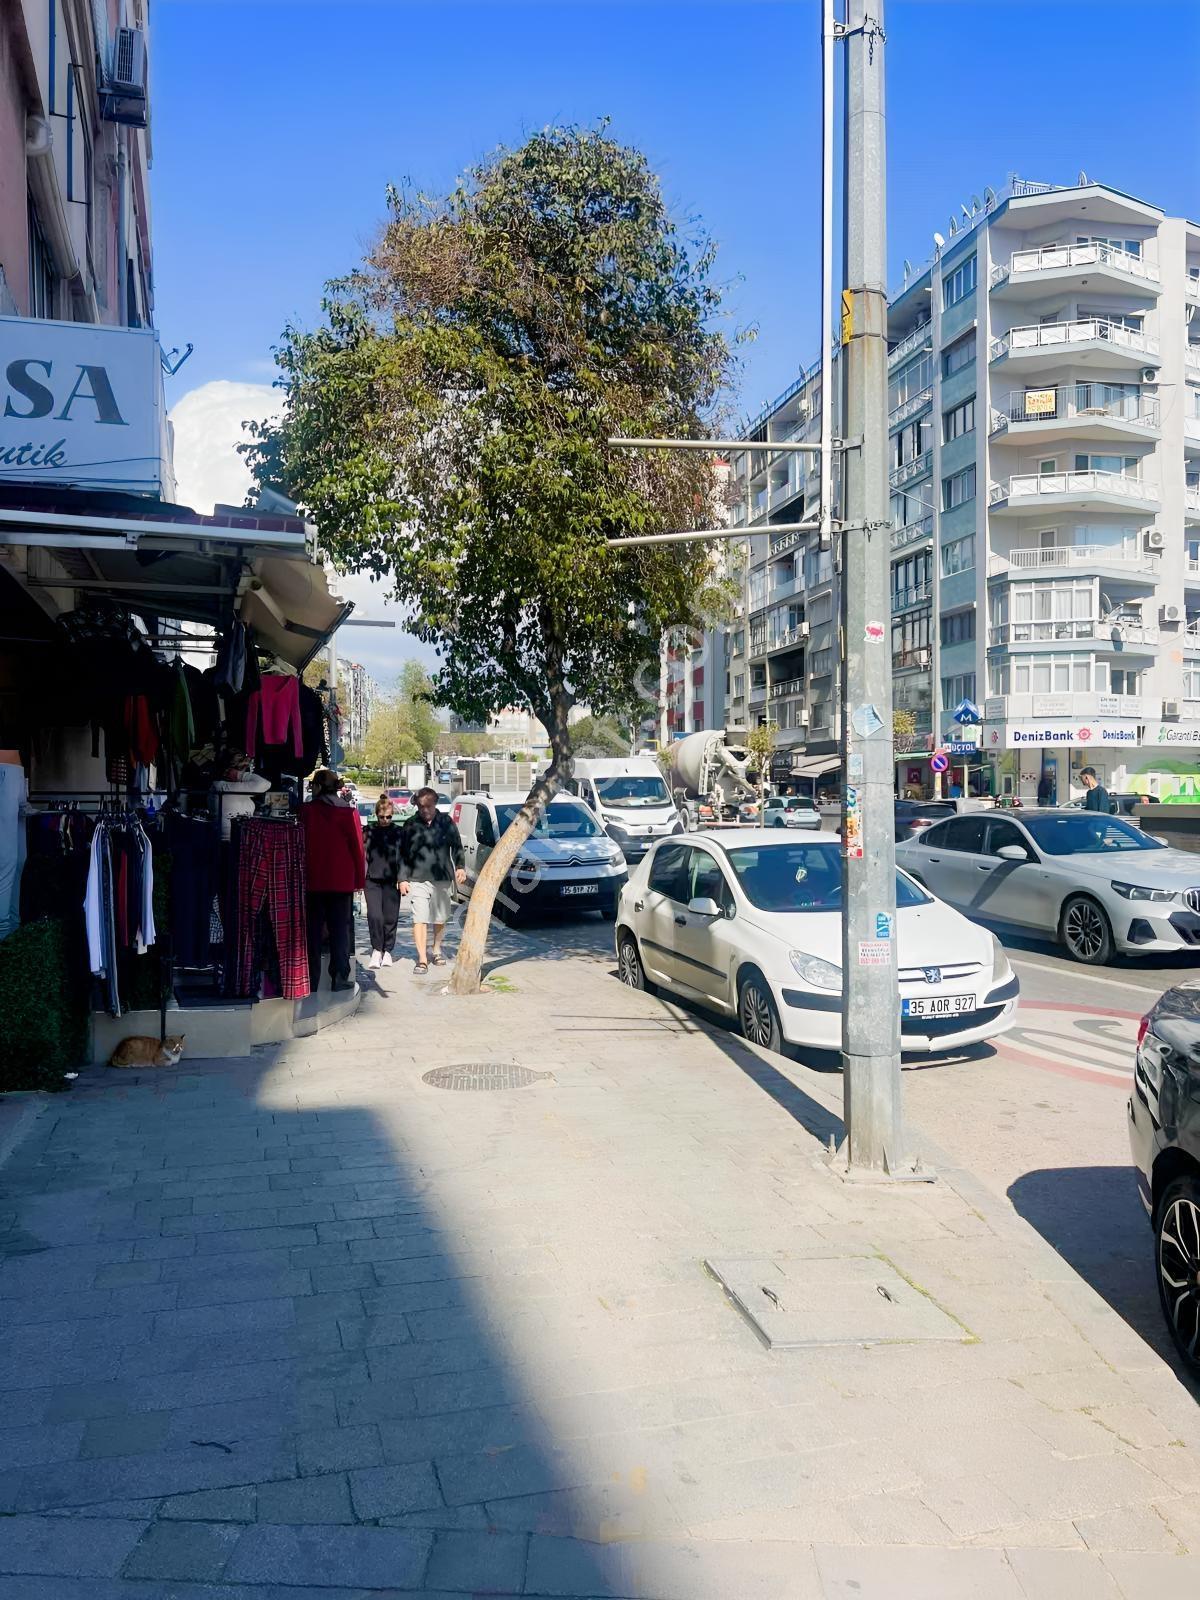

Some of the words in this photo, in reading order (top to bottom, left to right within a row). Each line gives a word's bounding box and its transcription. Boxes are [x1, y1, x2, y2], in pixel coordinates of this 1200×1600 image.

[1013, 730, 1074, 742] DenizBank
[1102, 729, 1136, 741] DenizBank
[910, 1001, 924, 1014] 35
[955, 996, 974, 1011] 927
